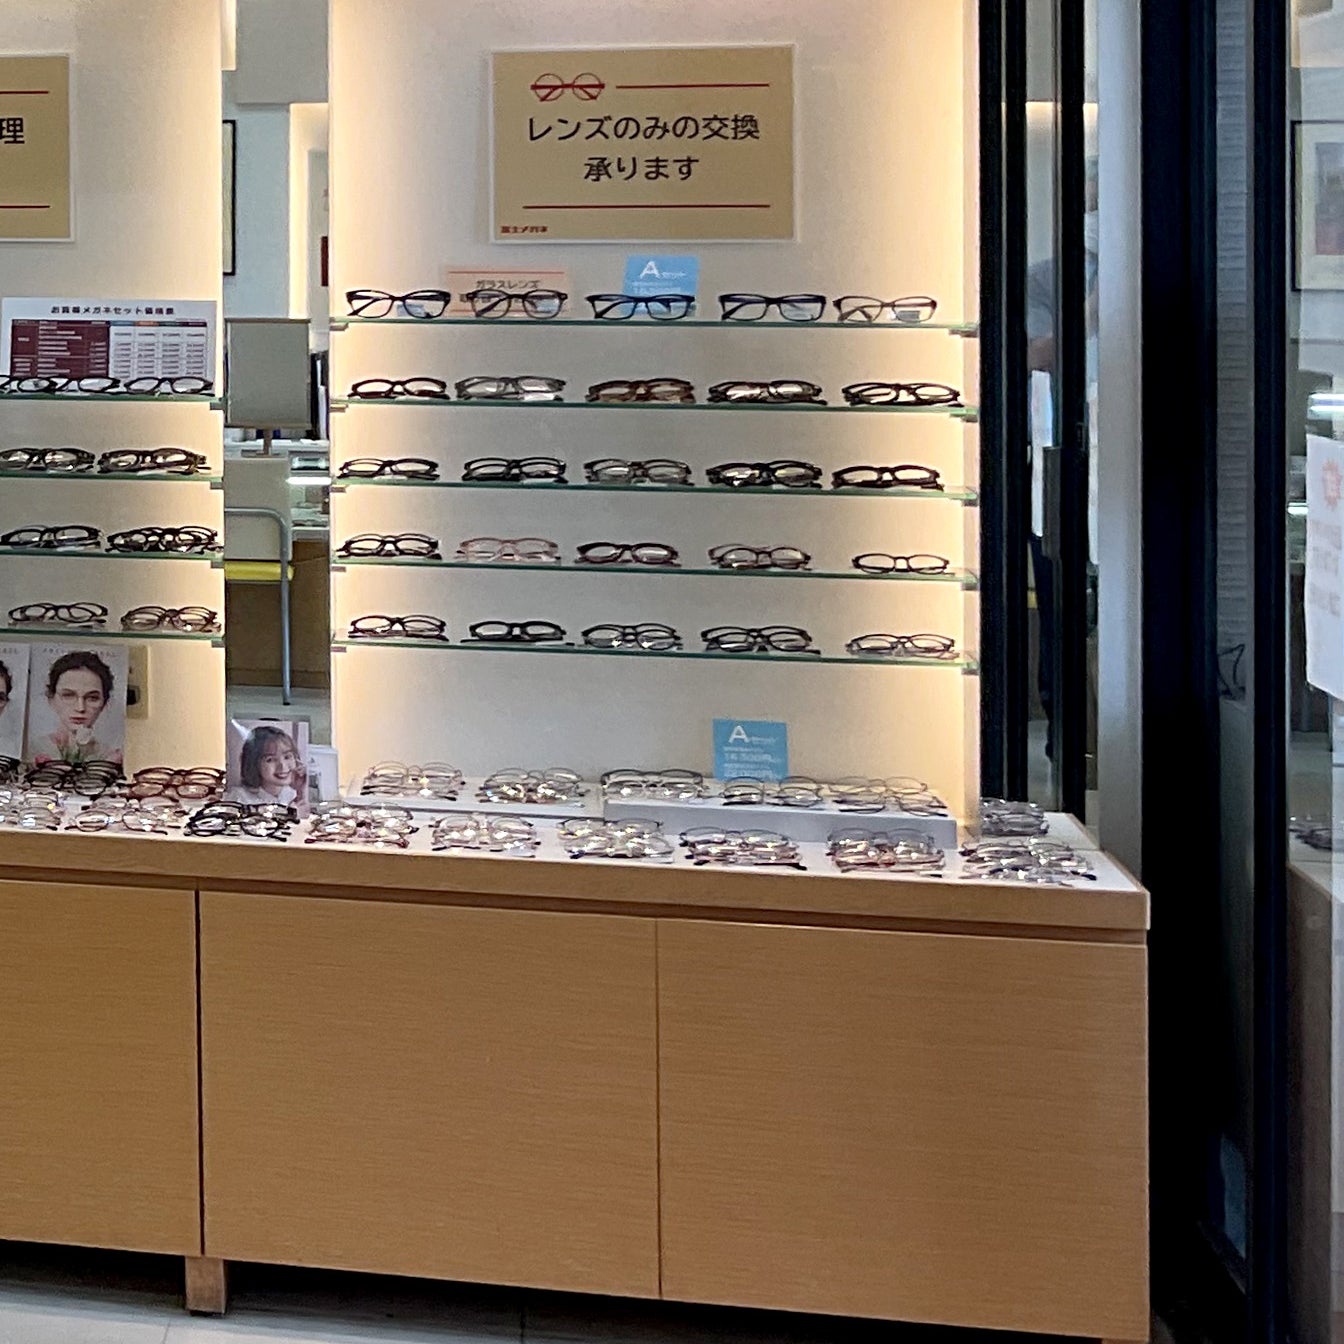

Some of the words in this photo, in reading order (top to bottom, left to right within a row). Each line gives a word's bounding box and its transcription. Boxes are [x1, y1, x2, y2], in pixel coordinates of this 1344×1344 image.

[528, 114, 760, 142] レンズのみの交換
[583, 155, 700, 181] 承ります
